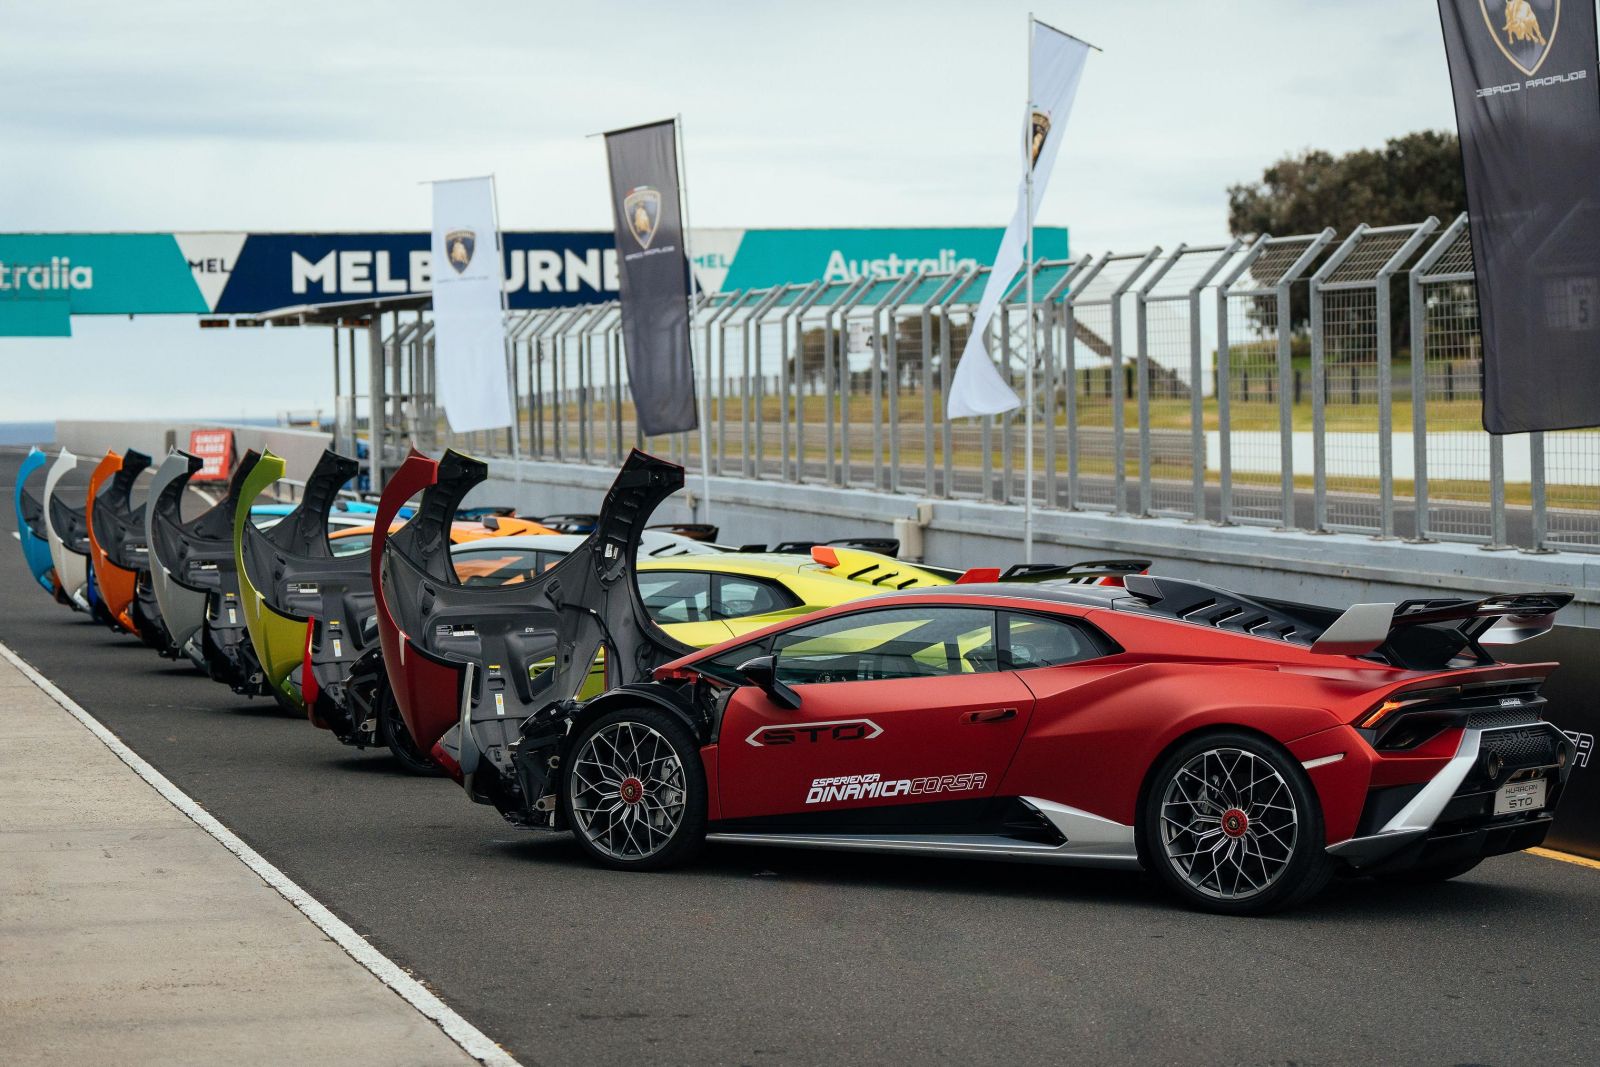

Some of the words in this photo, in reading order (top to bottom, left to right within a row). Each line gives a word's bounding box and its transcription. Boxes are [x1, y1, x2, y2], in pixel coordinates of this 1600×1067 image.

[188, 258, 232, 273] MEL
[292, 249, 620, 293] MELBURNE
[763, 724, 865, 745] STO
[812, 773, 881, 787] ESPERIENZA
[1508, 796, 1533, 809] STO
